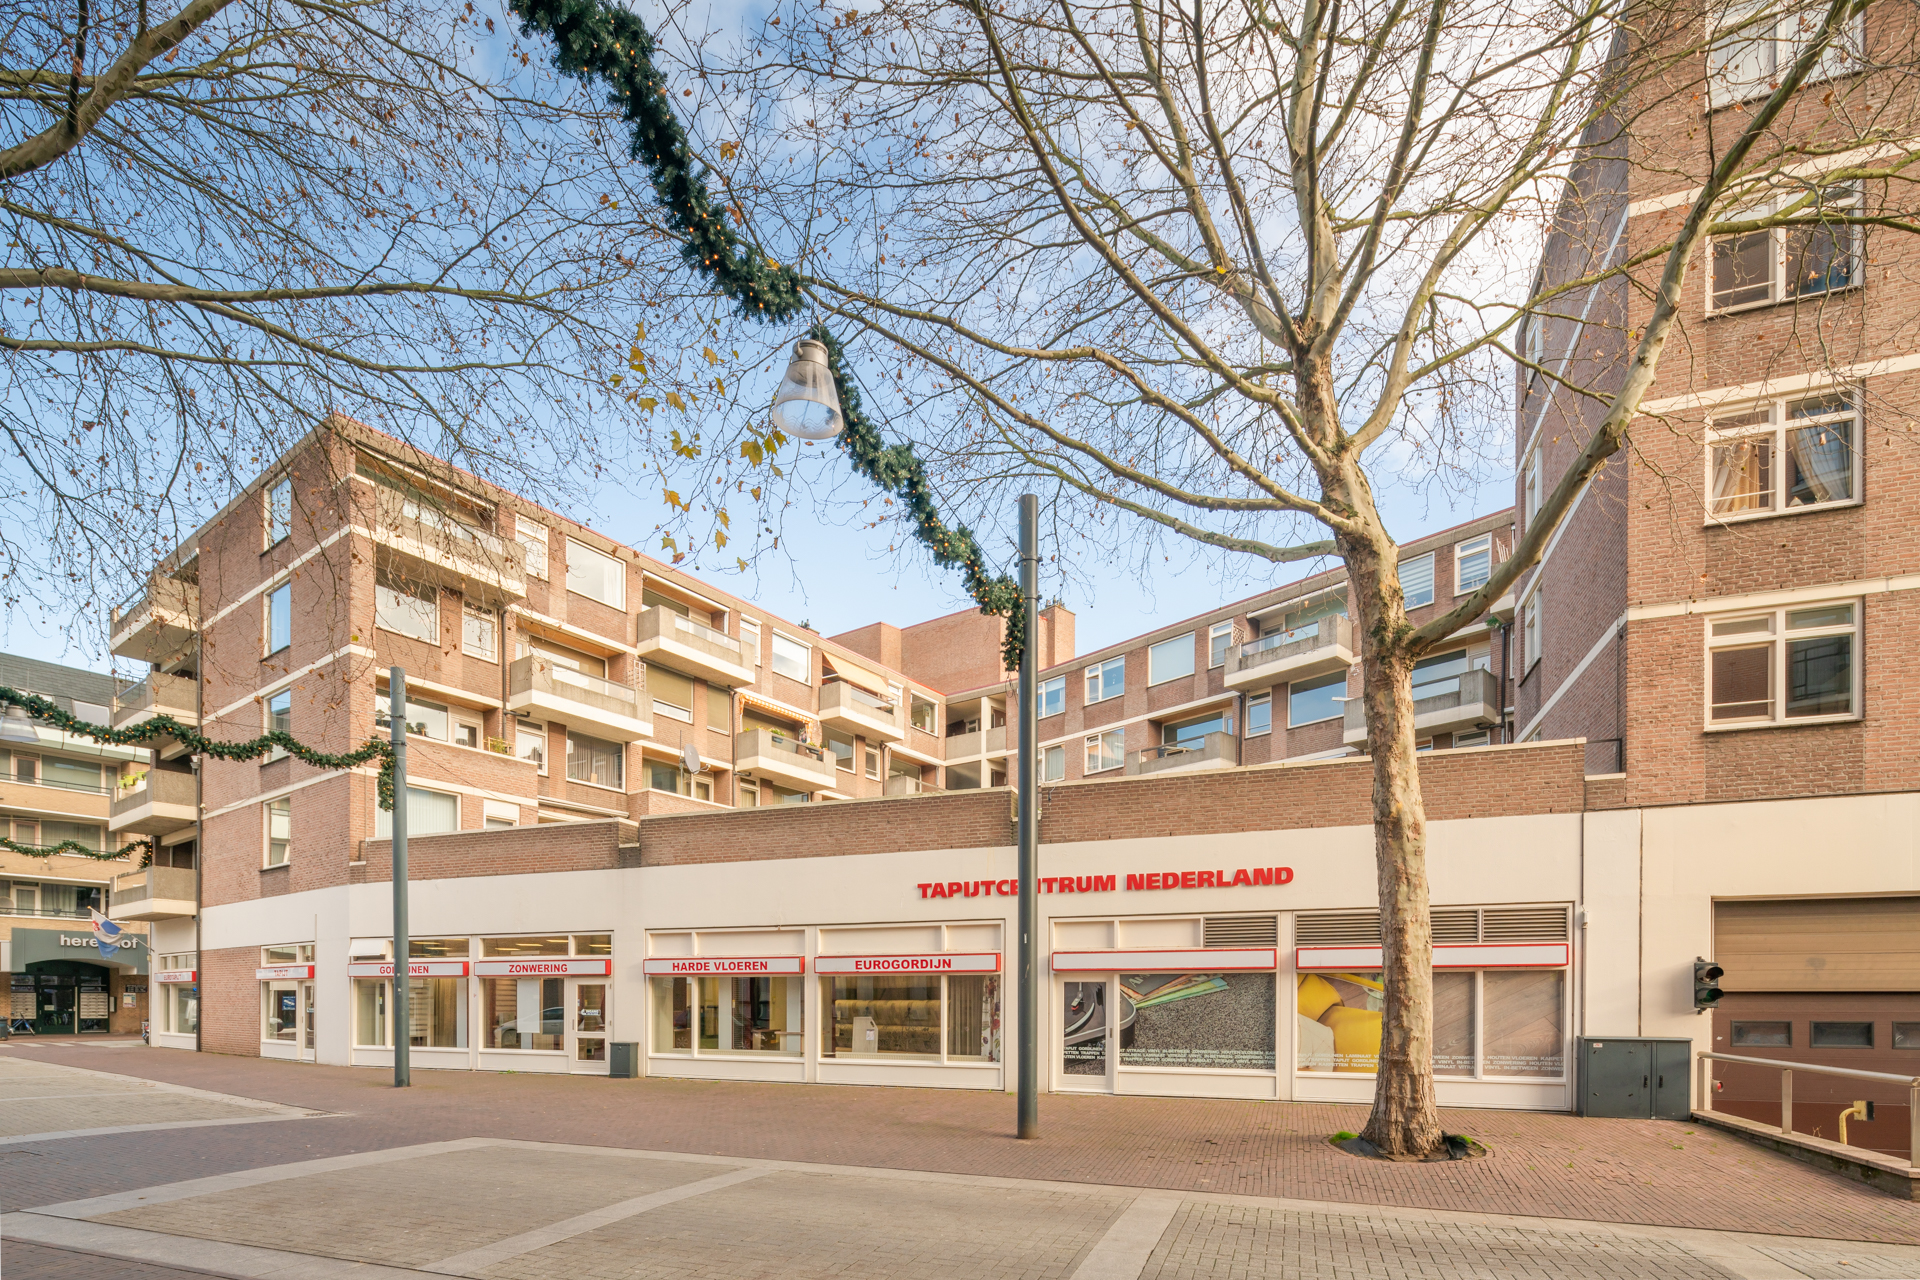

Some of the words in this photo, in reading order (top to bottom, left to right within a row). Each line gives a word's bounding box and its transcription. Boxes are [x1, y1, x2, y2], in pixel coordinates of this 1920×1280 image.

[917, 874, 1116, 899] TAPIJTCETRUM
[1126, 866, 1294, 891] NEDERLAND
[60, 934, 138, 949] hereof
[508, 963, 568, 974] ZONWERING
[672, 961, 710, 972] HARDE
[714, 960, 768, 971] VLOEREN
[855, 958, 952, 970] EUROGORDIJN
